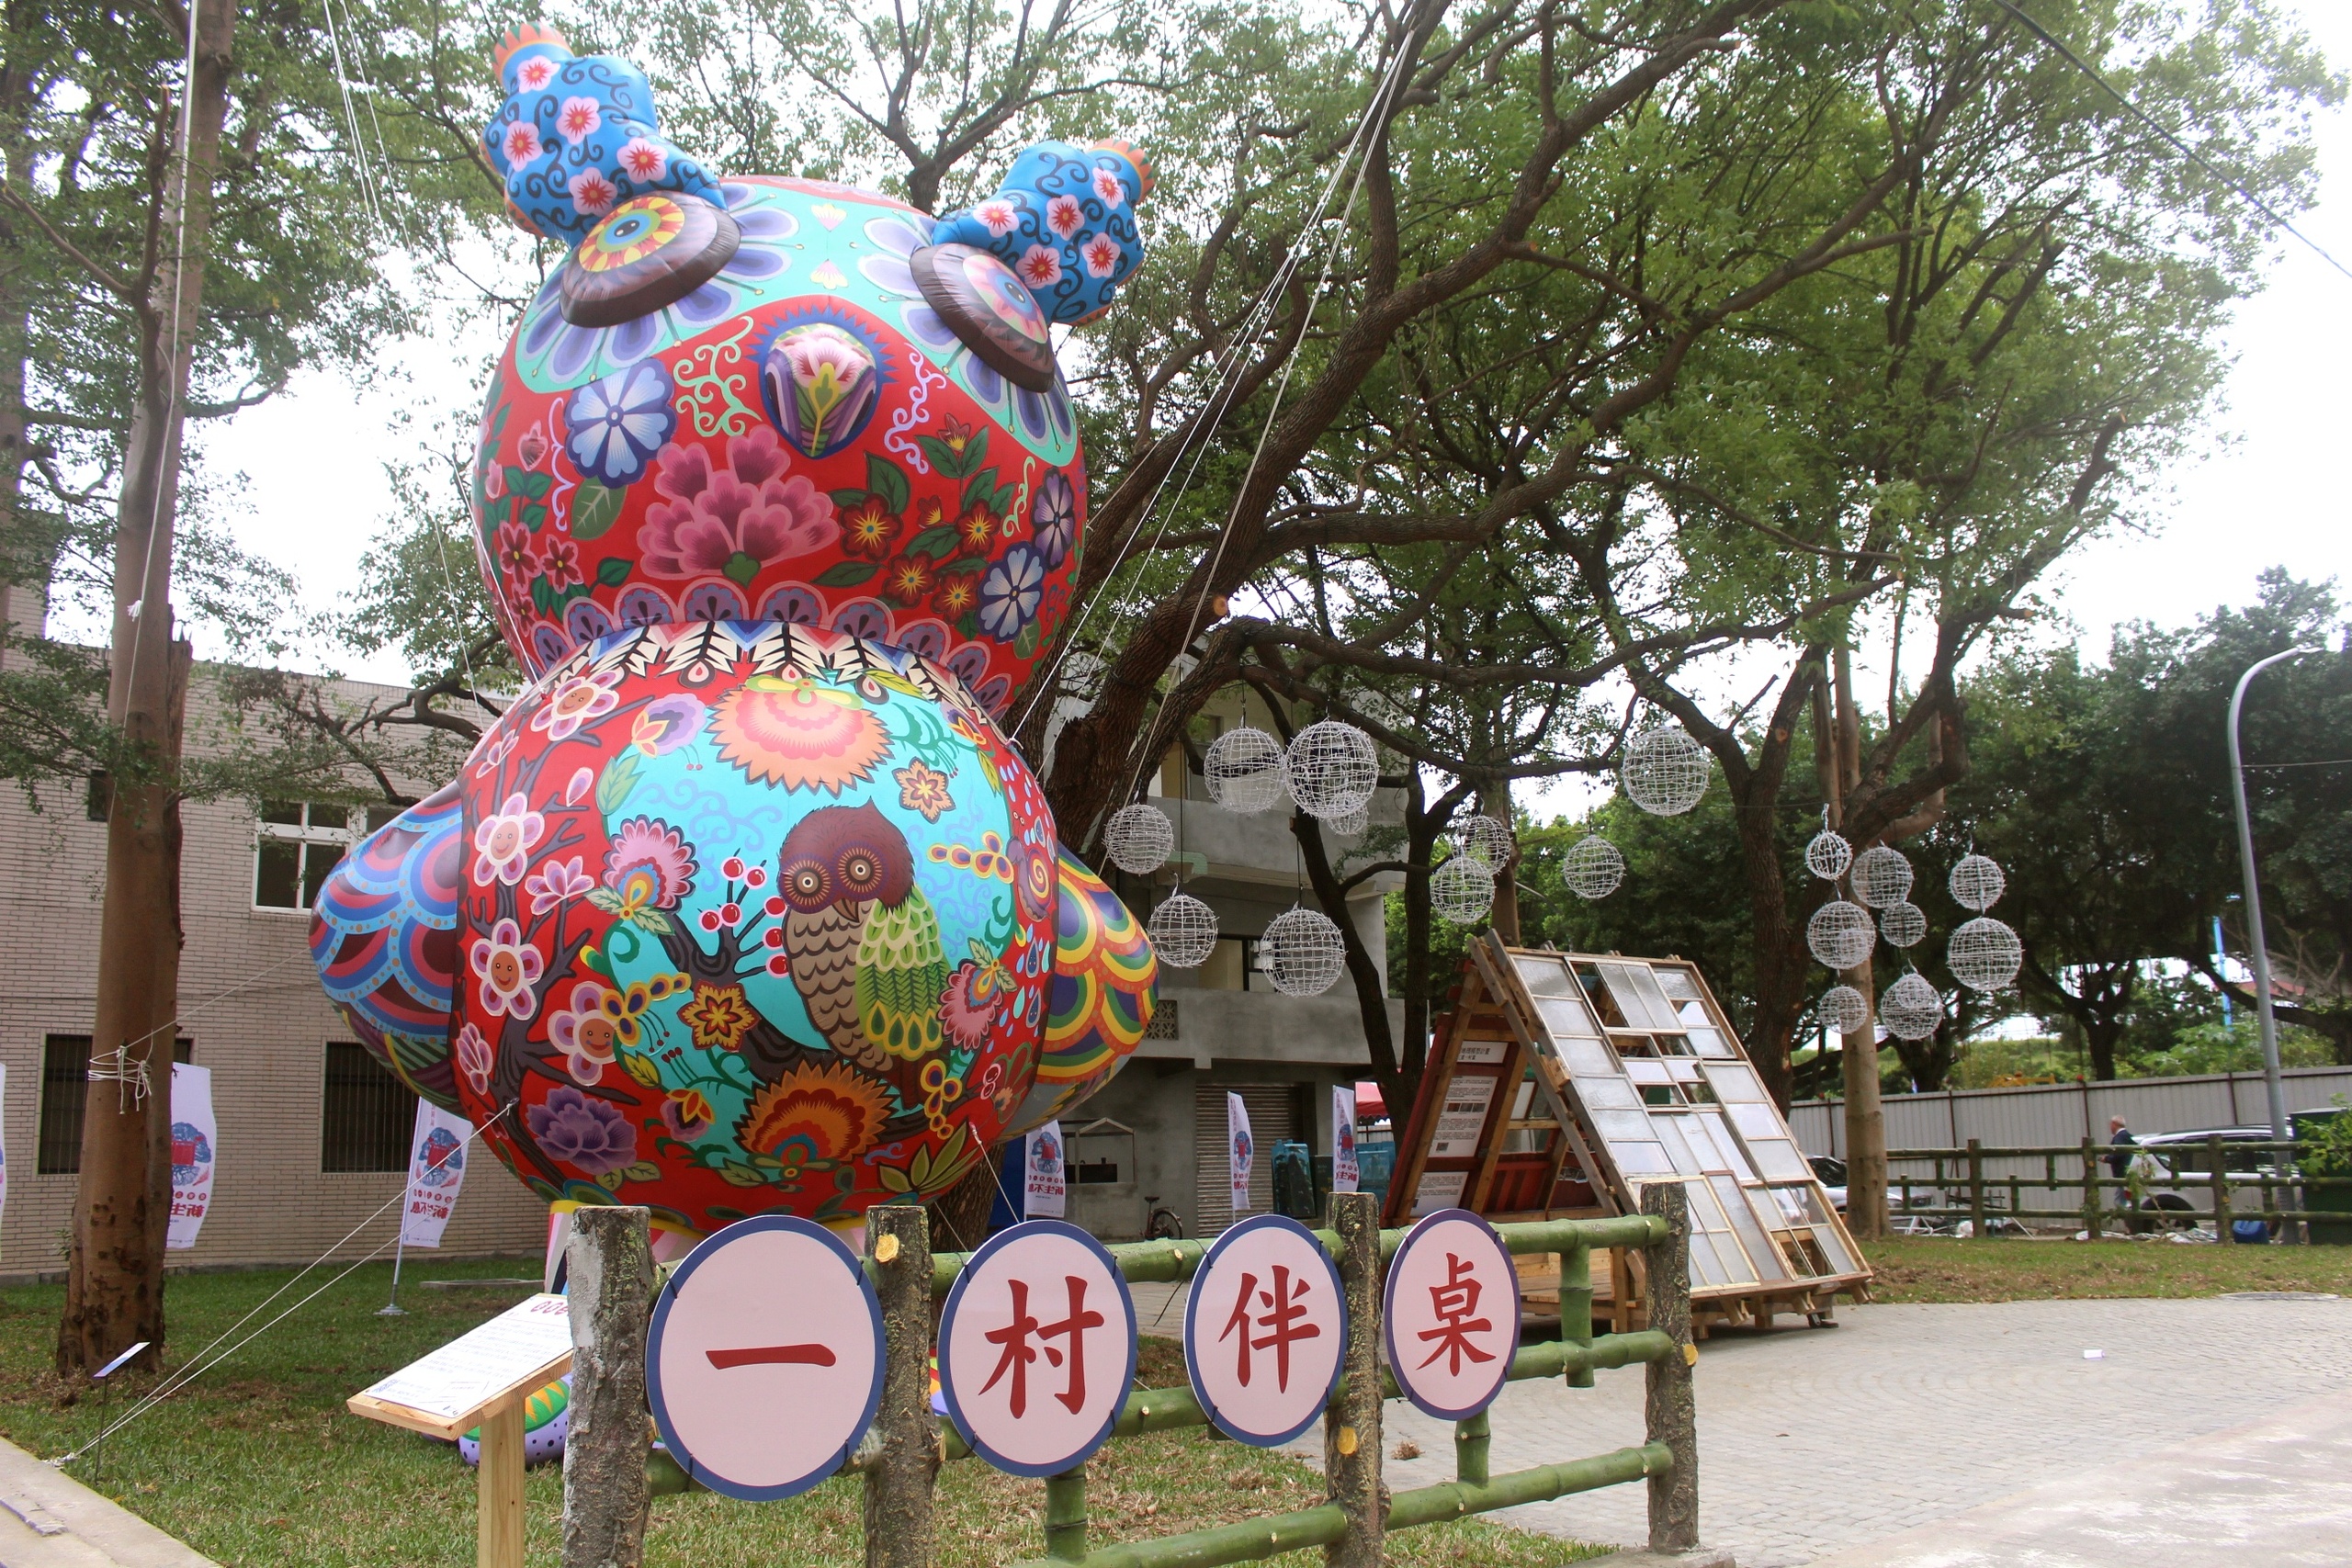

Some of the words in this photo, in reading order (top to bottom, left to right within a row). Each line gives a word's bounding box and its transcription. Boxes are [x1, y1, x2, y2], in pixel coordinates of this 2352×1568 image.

[706, 1343, 837, 1370] 一
[978, 1276, 1104, 1418] 村
[1218, 1265, 1320, 1393] 伴
[1415, 1253, 1496, 1377] 桌
